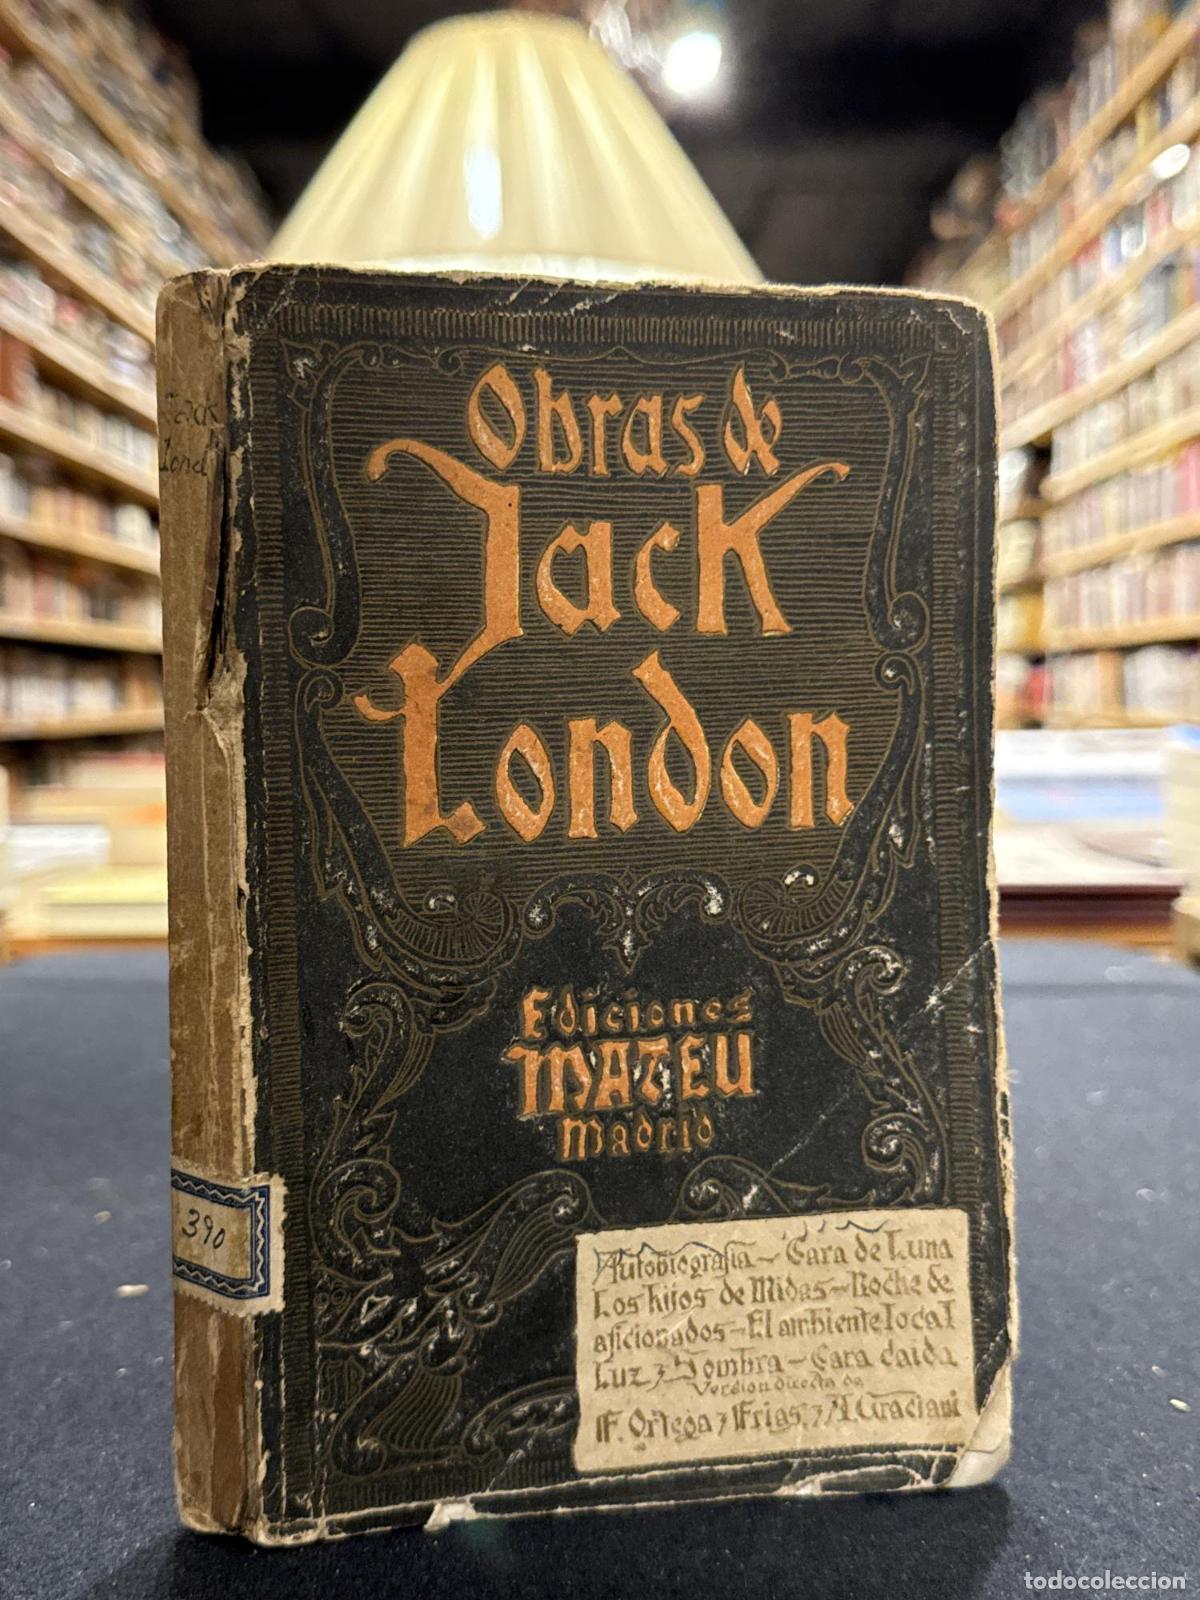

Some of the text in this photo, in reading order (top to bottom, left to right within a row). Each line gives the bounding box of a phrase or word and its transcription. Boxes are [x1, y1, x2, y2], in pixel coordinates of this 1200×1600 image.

[467, 361, 704, 477] Obras
[353, 636, 855, 848] London
[521, 985, 754, 1040] Ediciones
[502, 1031, 757, 1117] MATEU
[559, 1107, 715, 1161] Madrid
[181, 1207, 226, 1249] 390
[785, 1234, 849, 1266] Cara
[855, 1233, 881, 1263] de
[884, 1229, 954, 1262] Luna
[592, 1288, 645, 1319] Los
[642, 1281, 714, 1319] hijos
[746, 1309, 773, 1339] El
[880, 1299, 957, 1331] local
[593, 1361, 652, 1392] Luz
[810, 1343, 874, 1372] Cara
[628, 1407, 713, 1443] Ortega
